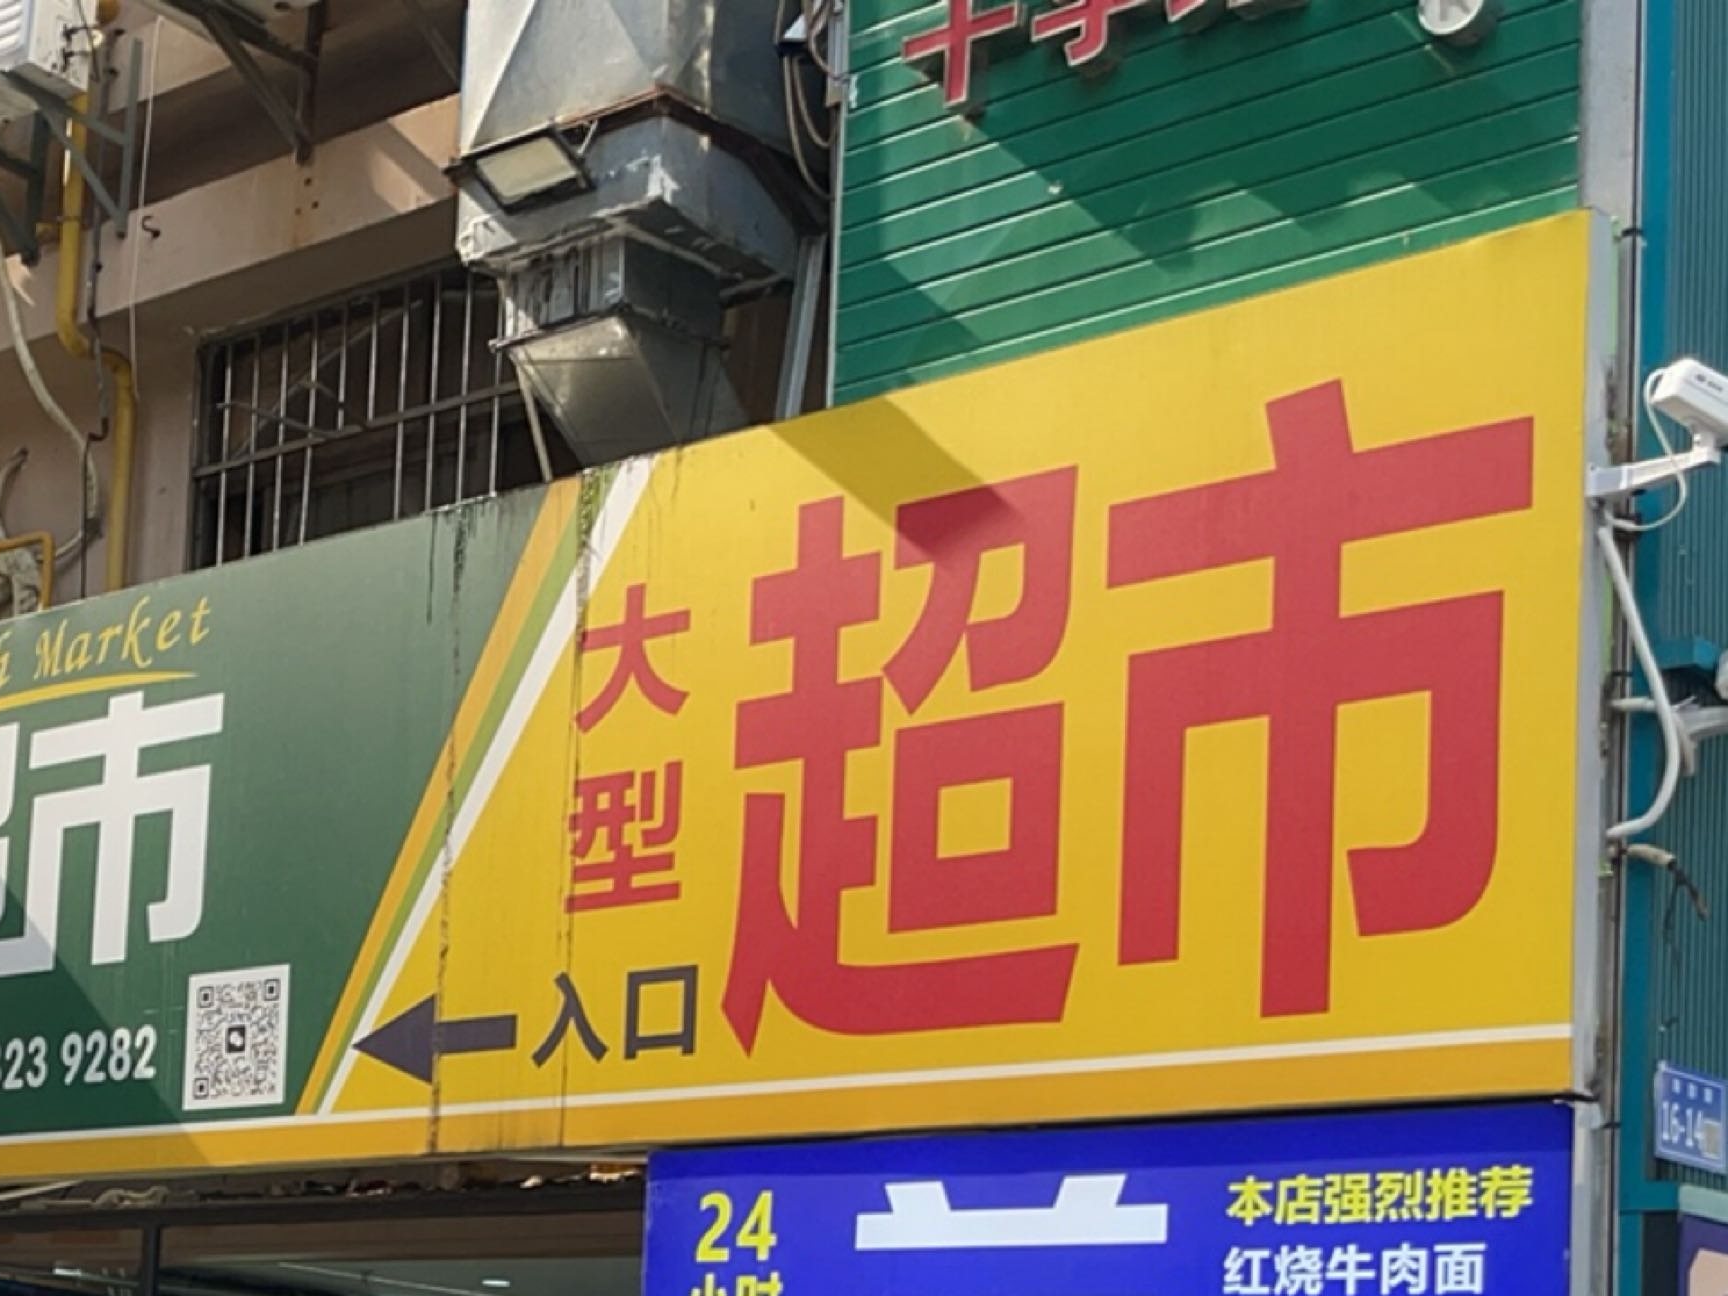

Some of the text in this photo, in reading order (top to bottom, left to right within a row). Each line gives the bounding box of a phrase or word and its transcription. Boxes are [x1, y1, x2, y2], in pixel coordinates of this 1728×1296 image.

[34, 596, 211, 680] Market
[563, 583, 691, 914] 大型
[720, 378, 1534, 1058] 超市
[531, 963, 700, 1068] 入口
[61, 1025, 157, 1085] 9282
[695, 1190, 778, 1263] 24
[1227, 1164, 1534, 1227] 本店强烈推荐
[1222, 1242, 1486, 1296] 红烧牛肉面
